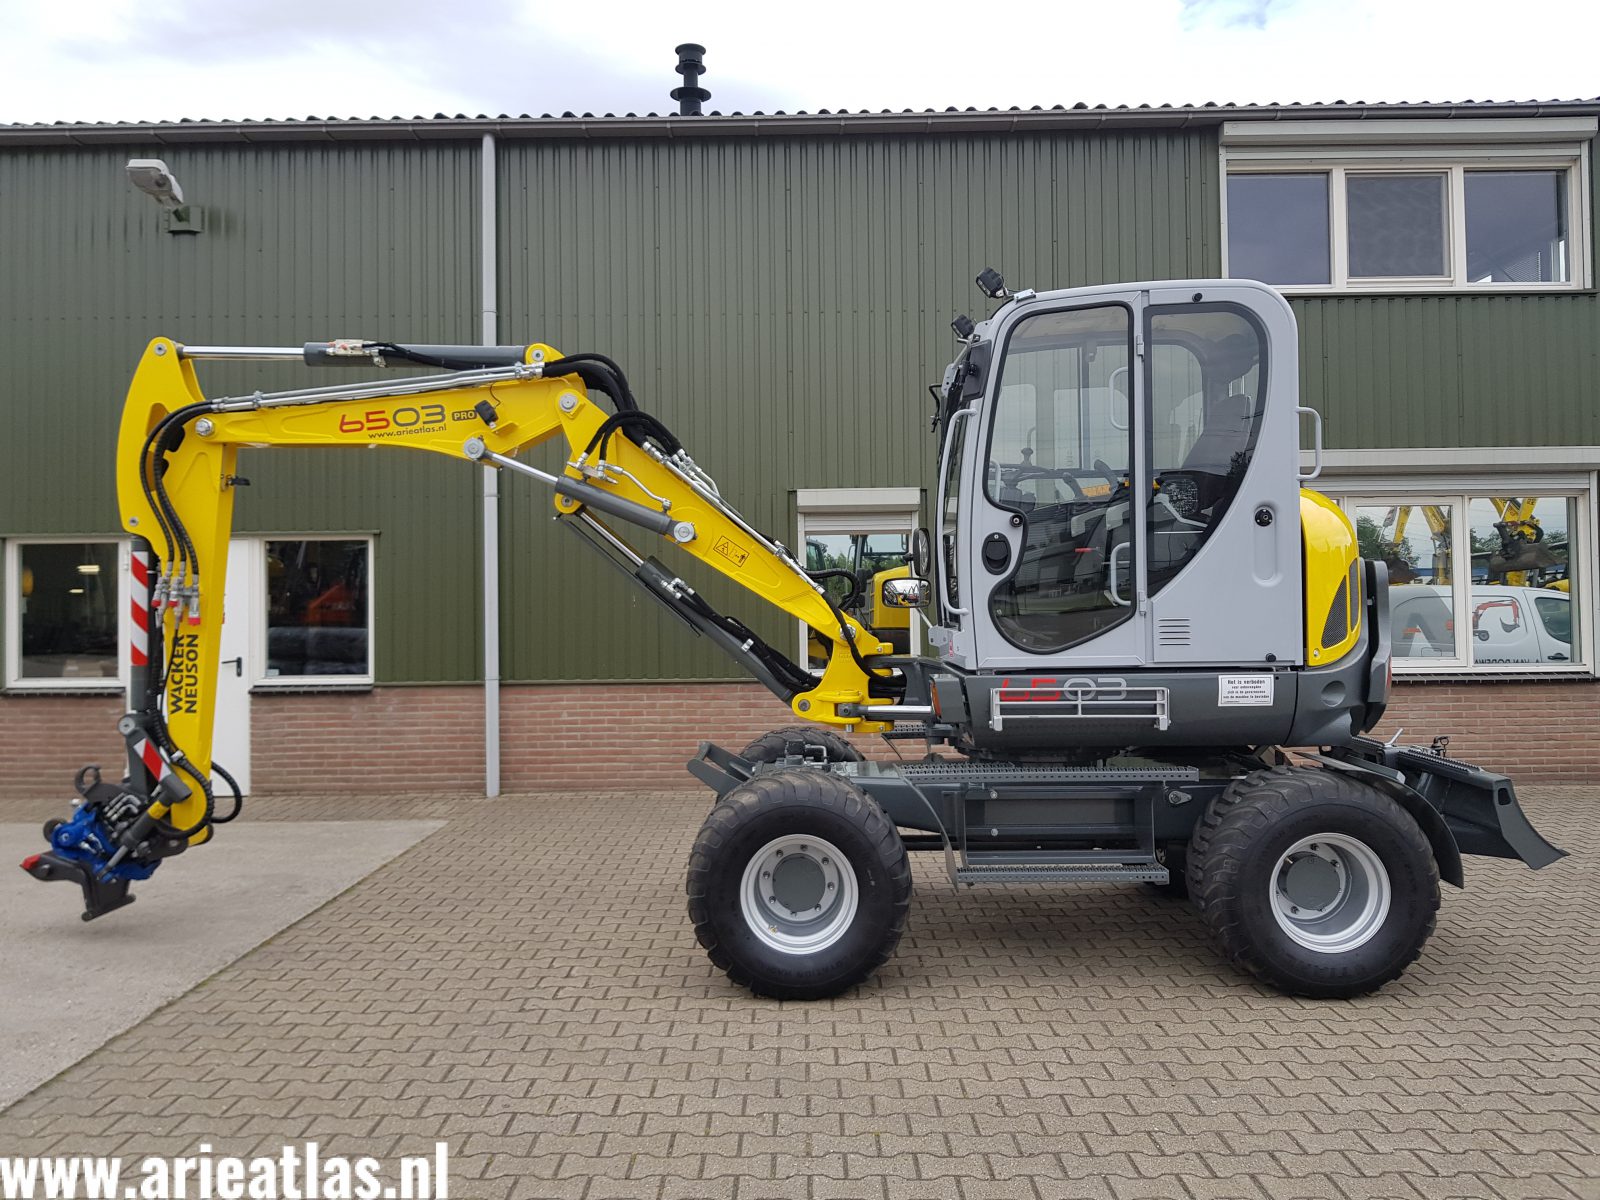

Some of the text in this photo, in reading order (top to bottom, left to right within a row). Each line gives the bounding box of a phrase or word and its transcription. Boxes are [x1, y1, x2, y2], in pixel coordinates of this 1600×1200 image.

[339, 404, 476, 433] 6503 PRO
[368, 423, 447, 439] www.arieatlas.nl
[184, 634, 199, 714] NEUSON
